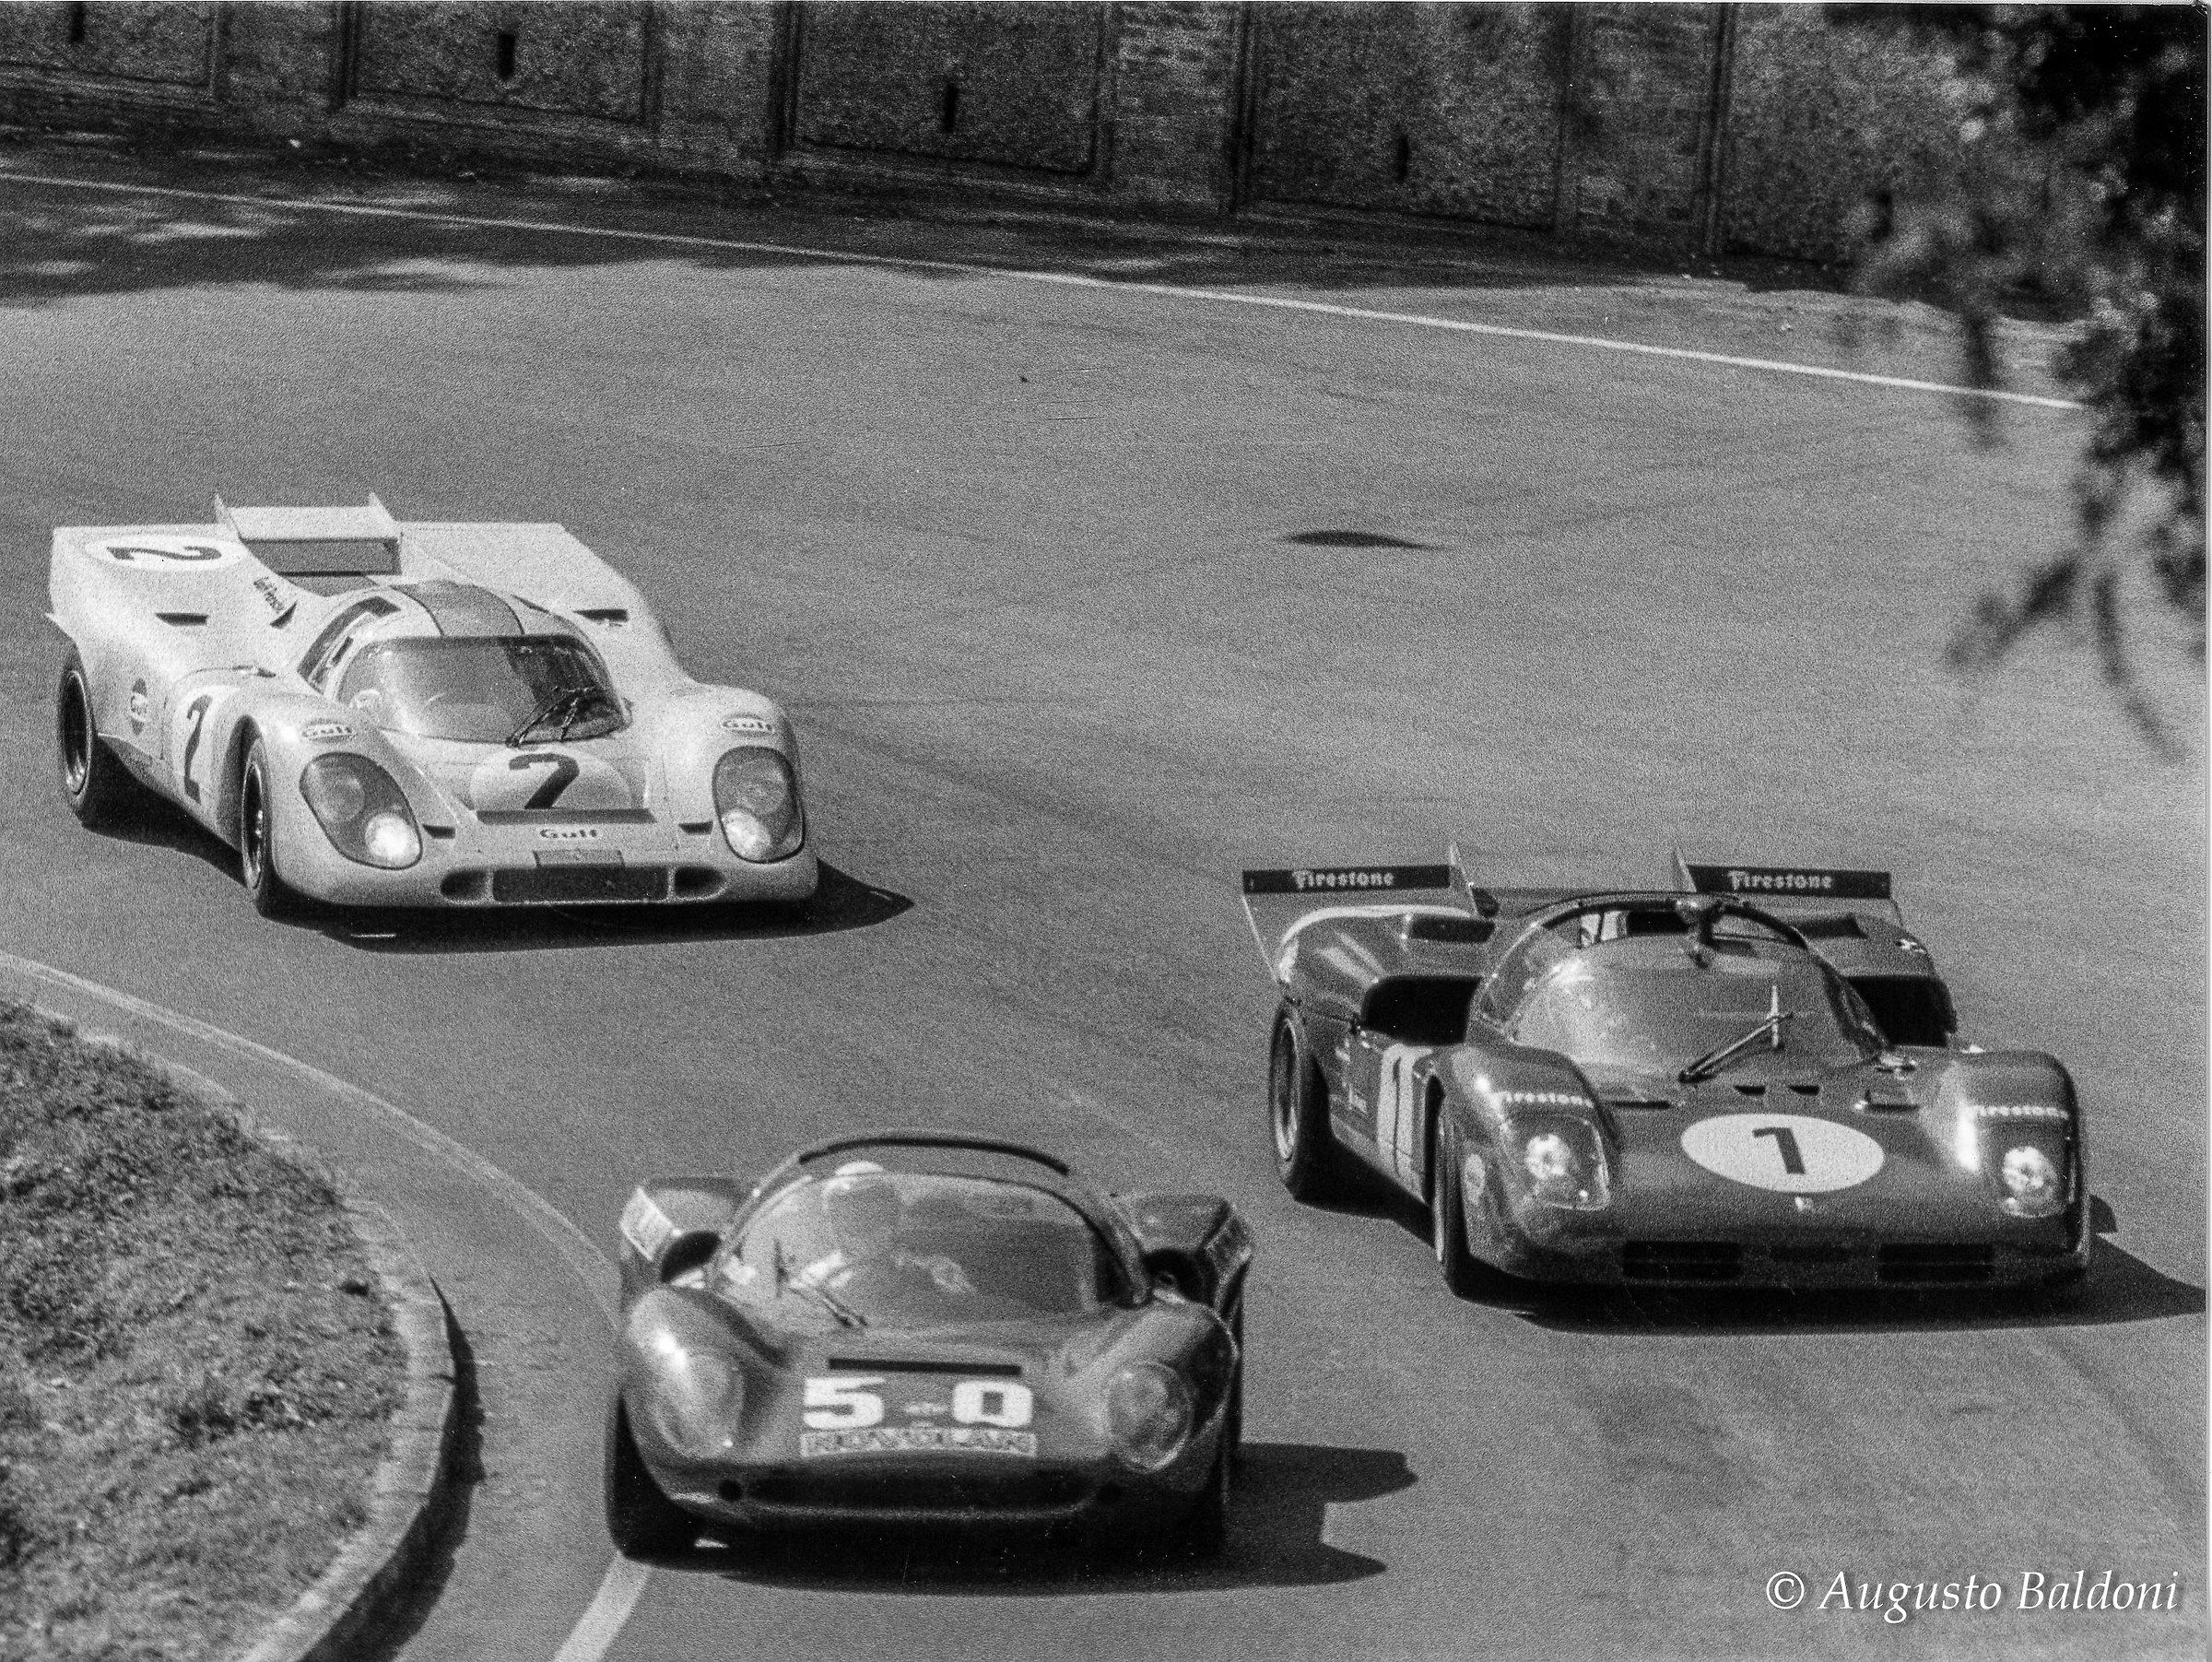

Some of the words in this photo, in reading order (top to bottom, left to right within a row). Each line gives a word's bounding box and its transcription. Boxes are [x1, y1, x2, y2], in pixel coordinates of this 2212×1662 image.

[106, 545, 222, 561] 2
[186, 693, 213, 807] 2
[539, 829, 599, 840] Gulf
[1291, 868, 1395, 890] Firestone
[1727, 869, 1833, 890] Firestone
